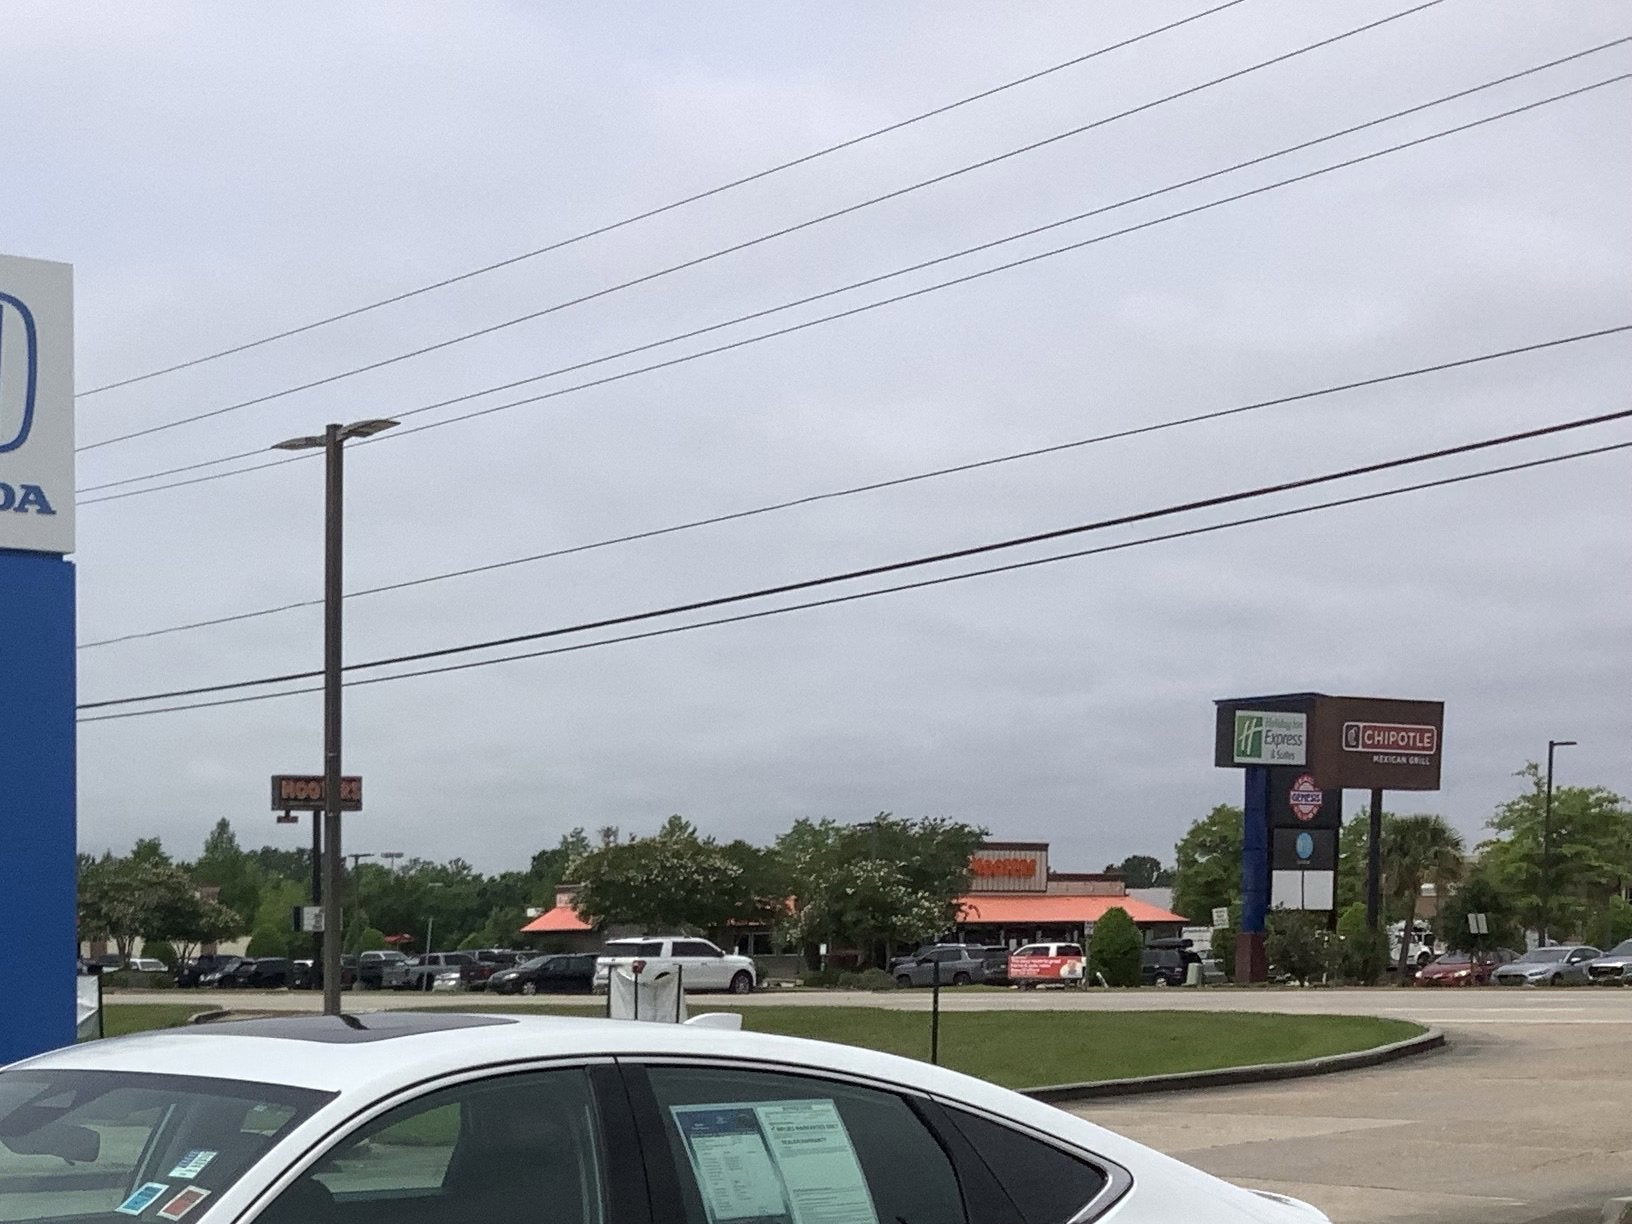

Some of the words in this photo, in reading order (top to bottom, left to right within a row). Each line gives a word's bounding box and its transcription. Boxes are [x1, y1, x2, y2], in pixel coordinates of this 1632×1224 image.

[1264, 729, 1303, 748] Express
[1364, 730, 1432, 747] CHIPOTLE
[1372, 755, 1407, 764] MEXICAN
[1408, 756, 1430, 766] GRILL
